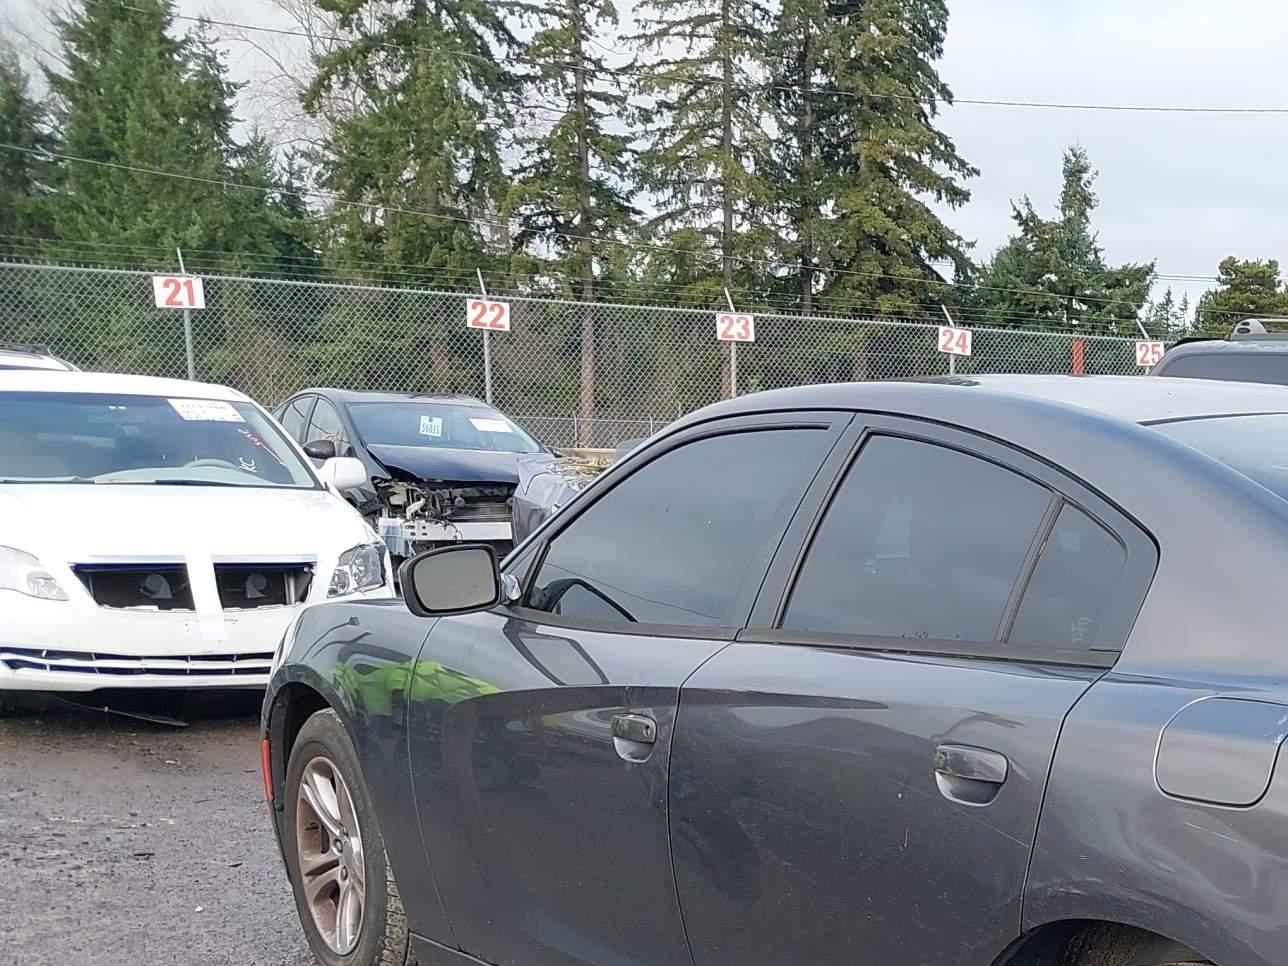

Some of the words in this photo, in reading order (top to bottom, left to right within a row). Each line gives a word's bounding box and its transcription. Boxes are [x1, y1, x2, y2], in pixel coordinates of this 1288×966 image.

[162, 278, 196, 306] 21
[471, 301, 506, 329] 22
[720, 315, 751, 340] 23
[941, 329, 968, 354] 24
[1139, 343, 1162, 364] 25
